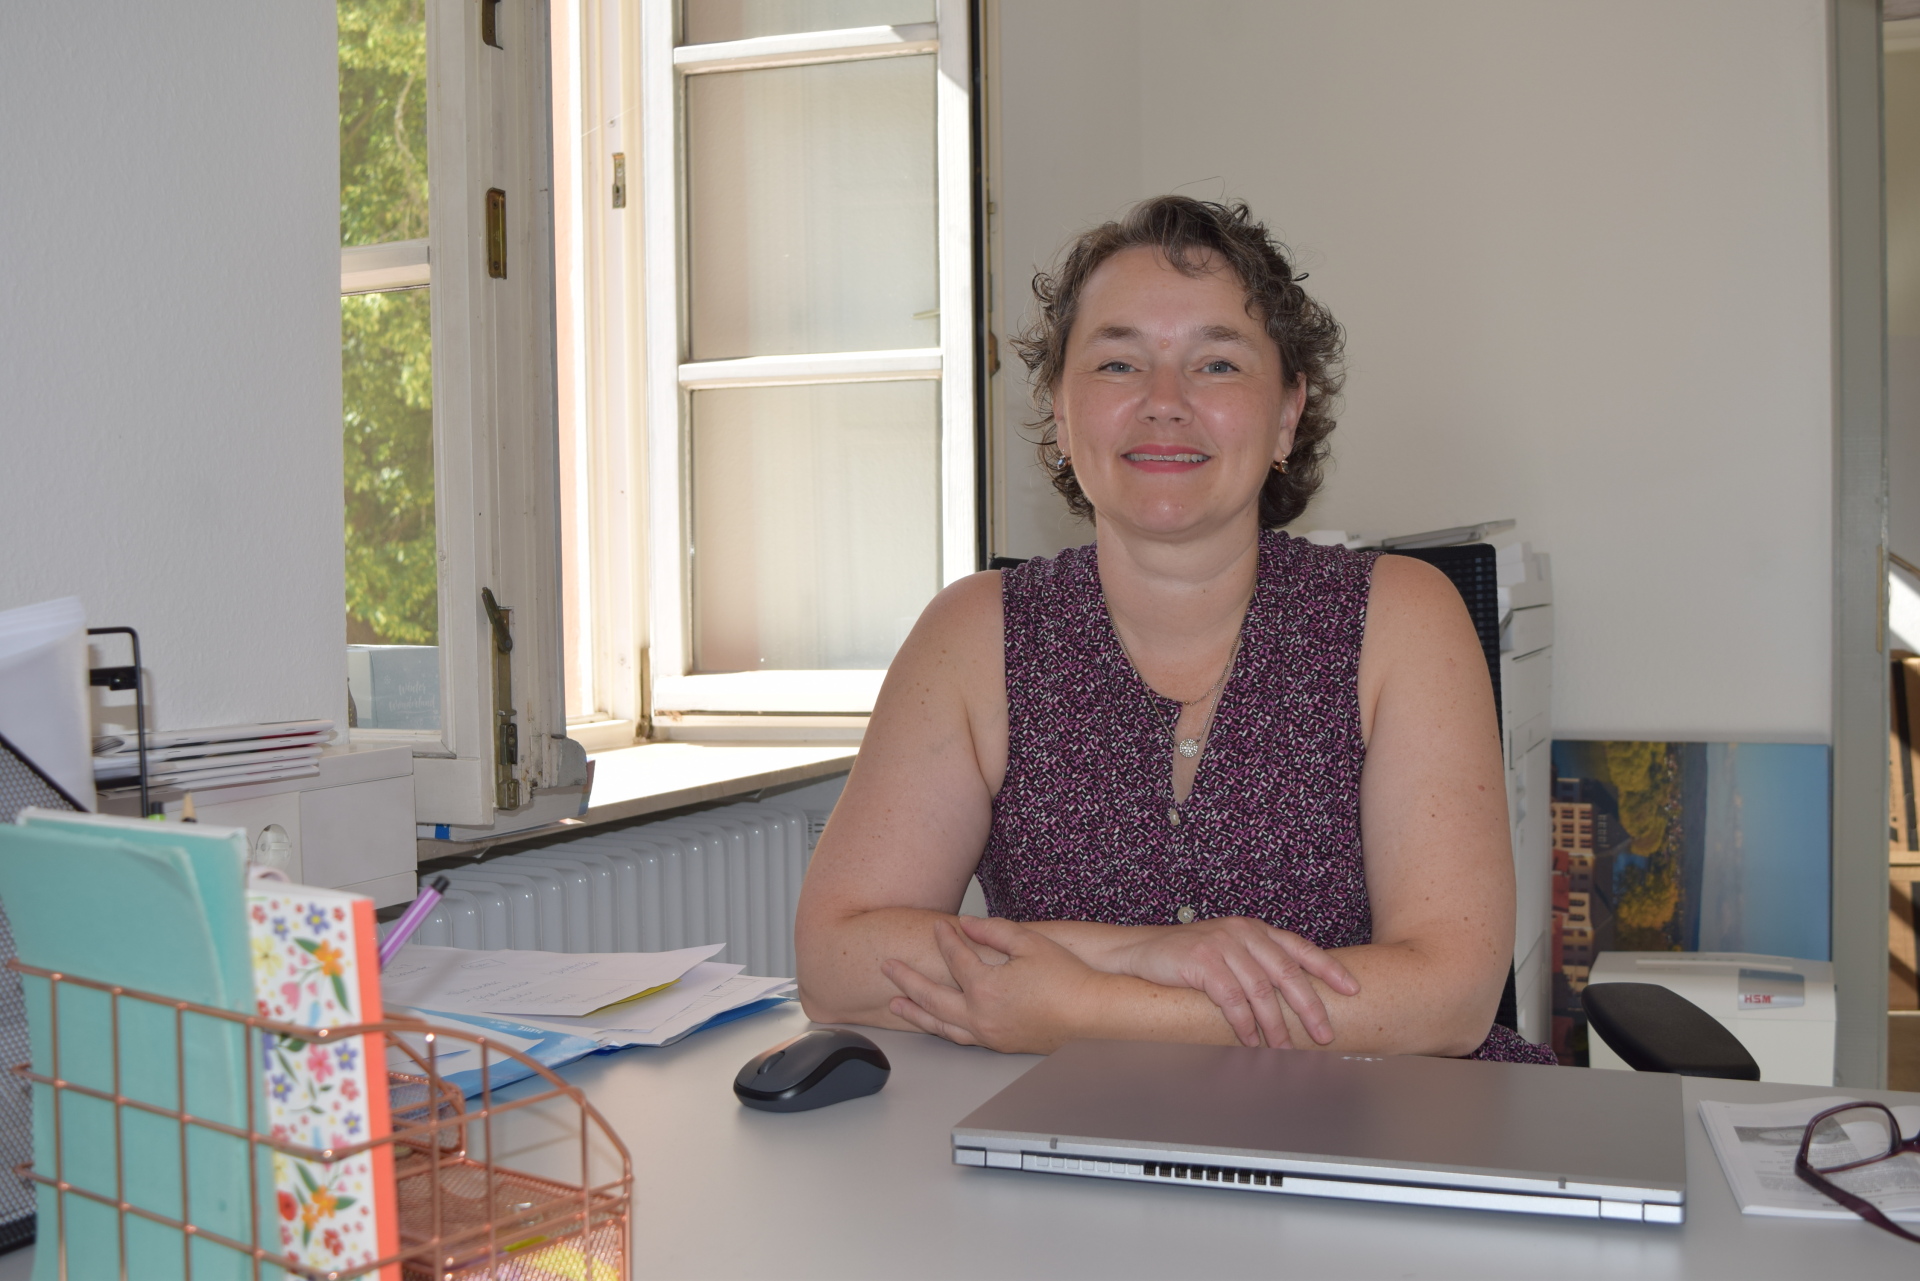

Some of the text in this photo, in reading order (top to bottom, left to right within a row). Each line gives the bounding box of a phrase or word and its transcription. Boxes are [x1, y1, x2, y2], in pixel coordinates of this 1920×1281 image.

[398, 680, 426, 696] Winter
[388, 694, 436, 712] Wonderland
[1744, 994, 1771, 1004] HSM
